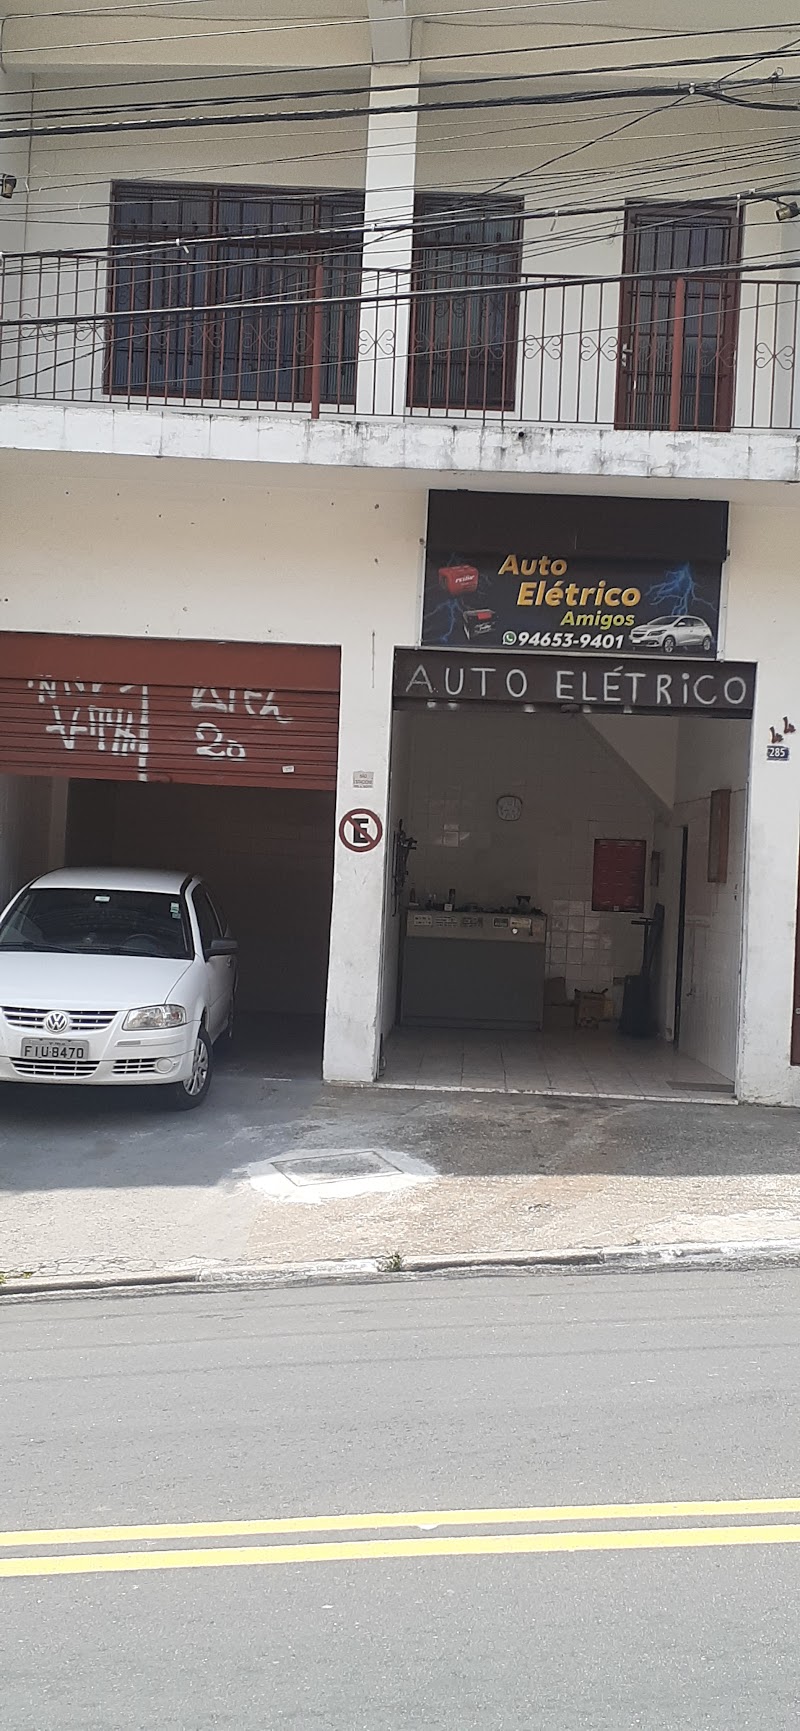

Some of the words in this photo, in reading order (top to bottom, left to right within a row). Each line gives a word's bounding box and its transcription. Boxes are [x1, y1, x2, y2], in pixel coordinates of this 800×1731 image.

[498, 554, 568, 576] Auto
[516, 580, 641, 607] Elétrico
[560, 610, 635, 630] Amigos
[518, 631, 624, 649] 94653-9401
[406, 664, 528, 698] AUTO
[769, 747, 786, 757] 285
